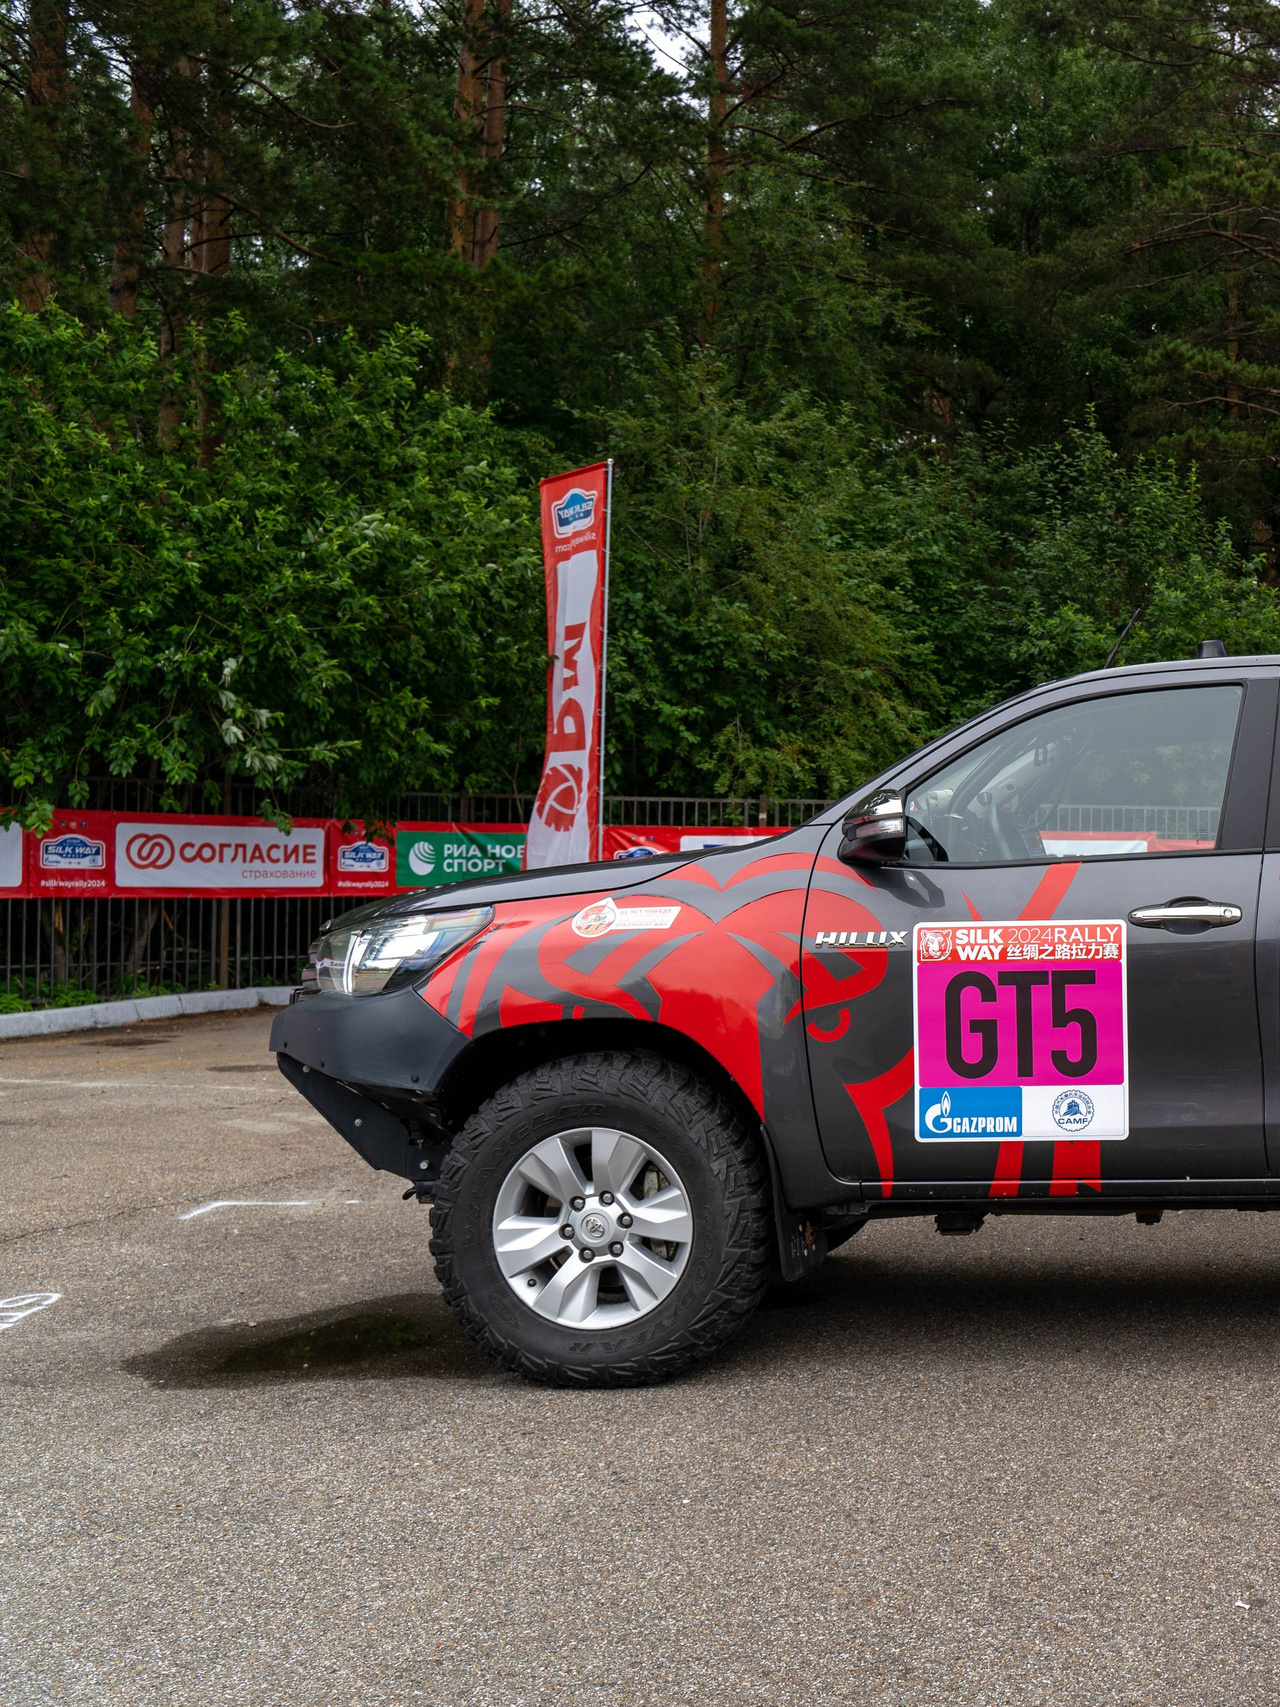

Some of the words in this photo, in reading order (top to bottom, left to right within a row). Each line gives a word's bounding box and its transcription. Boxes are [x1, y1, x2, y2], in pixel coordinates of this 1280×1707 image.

[47, 845, 73, 854] SILK
[75, 846, 98, 855] WAY
[180, 841, 316, 865] СОГЛАСИЕ
[344, 851, 364, 859] SILK
[443, 844, 482, 858] РИА
[443, 858, 507, 873] СПОРТ
[242, 868, 317, 880] страхование
[40, 879, 105, 889] #silkwayrally2024
[815, 931, 909, 948] HILUX
[955, 929, 1003, 944] SILK
[1008, 928, 1053, 944] 2024
[1054, 926, 1119, 943] RALLY
[956, 945, 1004, 961] WAY
[1006, 944, 1119, 960] 丝绸之路拉力赛
[944, 969, 1098, 1079] GT5
[952, 1116, 1018, 1134] GAZPROM
[1058, 1117, 1088, 1125] CAMF
